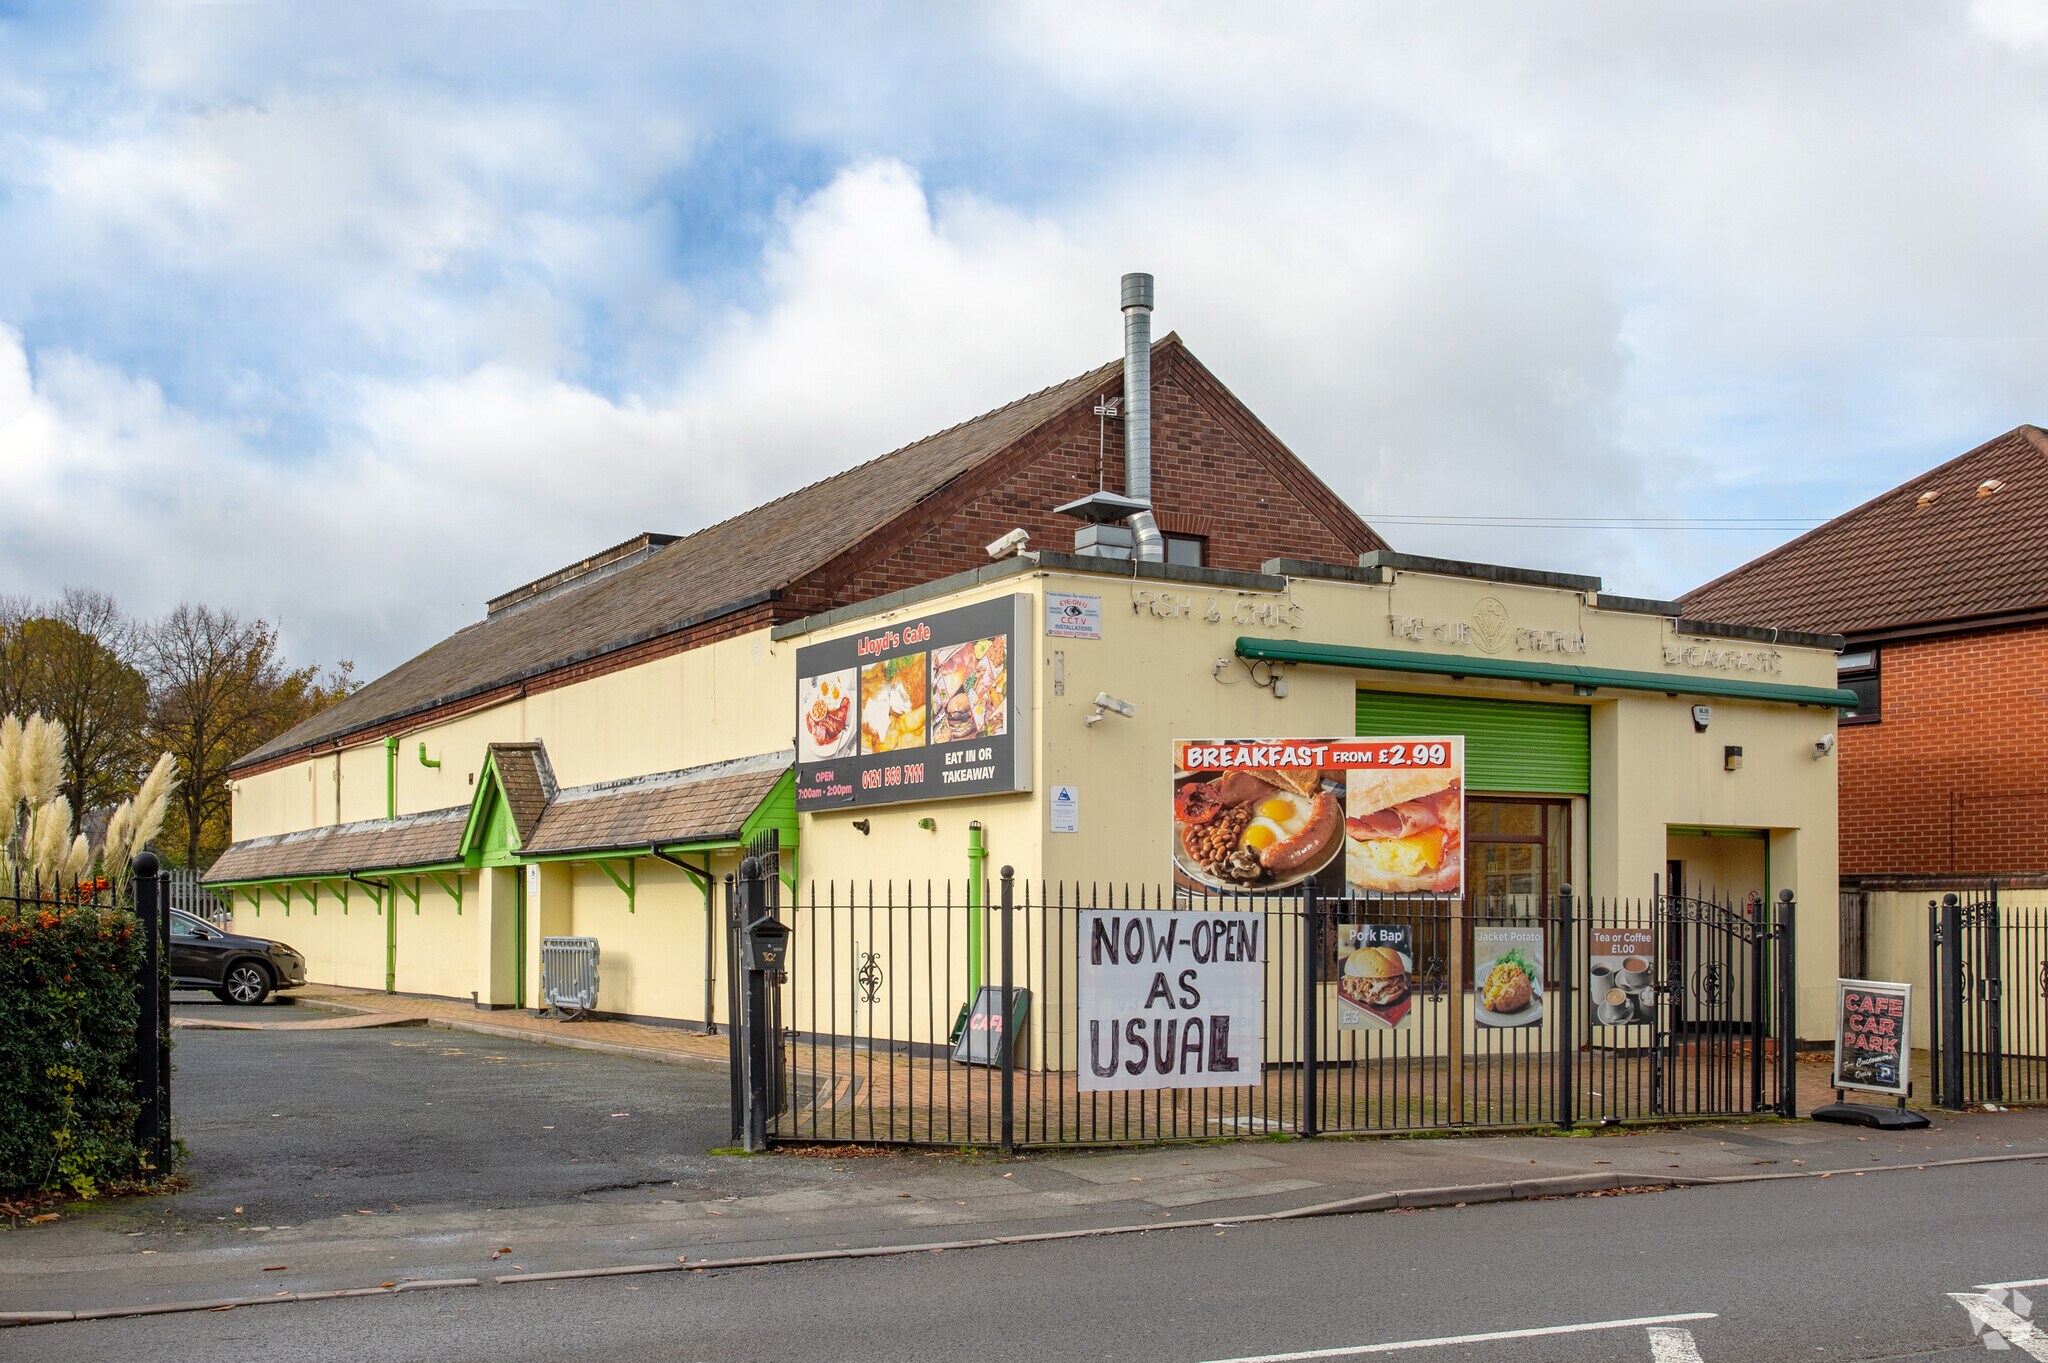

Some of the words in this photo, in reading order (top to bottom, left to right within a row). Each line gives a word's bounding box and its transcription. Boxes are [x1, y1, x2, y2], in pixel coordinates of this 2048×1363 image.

[1136, 591, 1191, 619] FISH
[1204, 597, 1220, 623] &
[1233, 599, 1305, 630] CHIPS
[857, 631, 900, 656] Lloyd's
[903, 622, 931, 645] Cafe
[1055, 624, 1093, 632] INSTALLATIONS
[1389, 614, 1424, 640] THE
[1434, 619, 1471, 646] SUB
[1515, 627, 1586, 654] STATION
[945, 751, 964, 765] EAT
[965, 749, 976, 763] IN
[978, 747, 993, 761] OR
[1187, 745, 1329, 768] BREAKFAST
[1332, 750, 1374, 764] FROM
[1378, 743, 1447, 768] £2.99
[815, 770, 834, 783] OPEN
[861, 769, 882, 789] 0121
[904, 763, 925, 784] 7111
[942, 765, 996, 784] TAKEAWAY
[798, 788, 822, 799] 7:00am
[826, 784, 853, 797] 2:00pm
[1090, 916, 1259, 965] NOW-OPEN
[1349, 929, 1376, 942] Pork
[1380, 929, 1403, 944] Bap
[1477, 931, 1508, 942] Jacket
[1510, 931, 1541, 942] Potato
[1594, 933, 1610, 942] Tea
[1612, 934, 1622, 942] or
[1624, 932, 1652, 943] Coffee
[1611, 944, 1635, 954] £1.00
[1144, 969, 1201, 1009] AS
[1342, 1010, 1360, 1024] £3
[1845, 994, 1904, 1017] CAFE
[1850, 1014, 1895, 1037] CAR
[1090, 1015, 1240, 1078] USUAL
[1845, 1032, 1898, 1058] PARK
